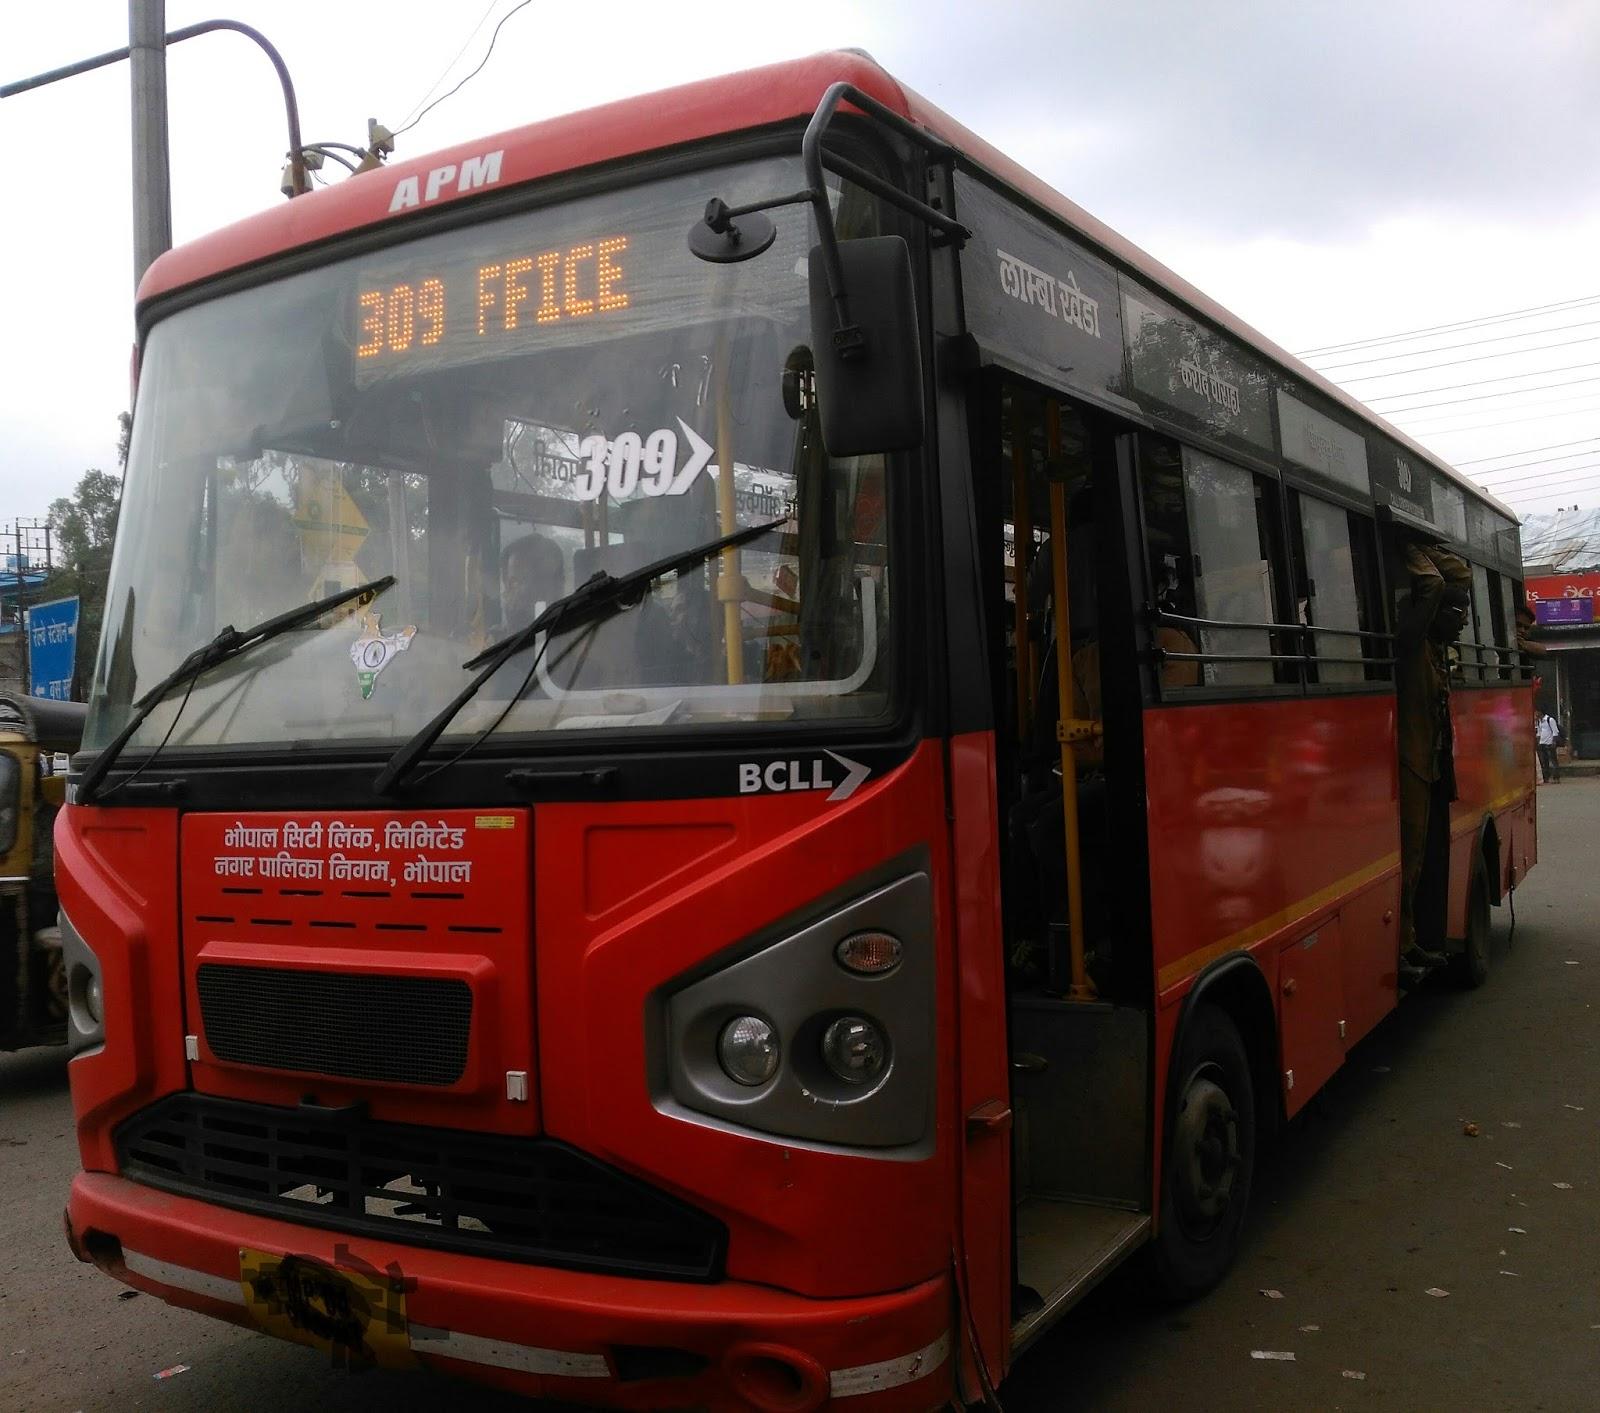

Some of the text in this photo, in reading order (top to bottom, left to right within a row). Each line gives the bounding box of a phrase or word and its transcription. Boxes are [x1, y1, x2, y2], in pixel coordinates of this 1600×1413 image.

[388, 150, 504, 213] APM
[358, 236, 628, 357] 309 FFICE
[575, 428, 677, 500] 309
[739, 760, 833, 793] BCLL
[225, 821, 278, 848] भोपाल
[283, 821, 323, 848] सिटी
[328, 821, 381, 852] लिंक,
[384, 820, 466, 849] लिमिटेड
[214, 851, 472, 887] नगर पालिका निगम, भोपाल
